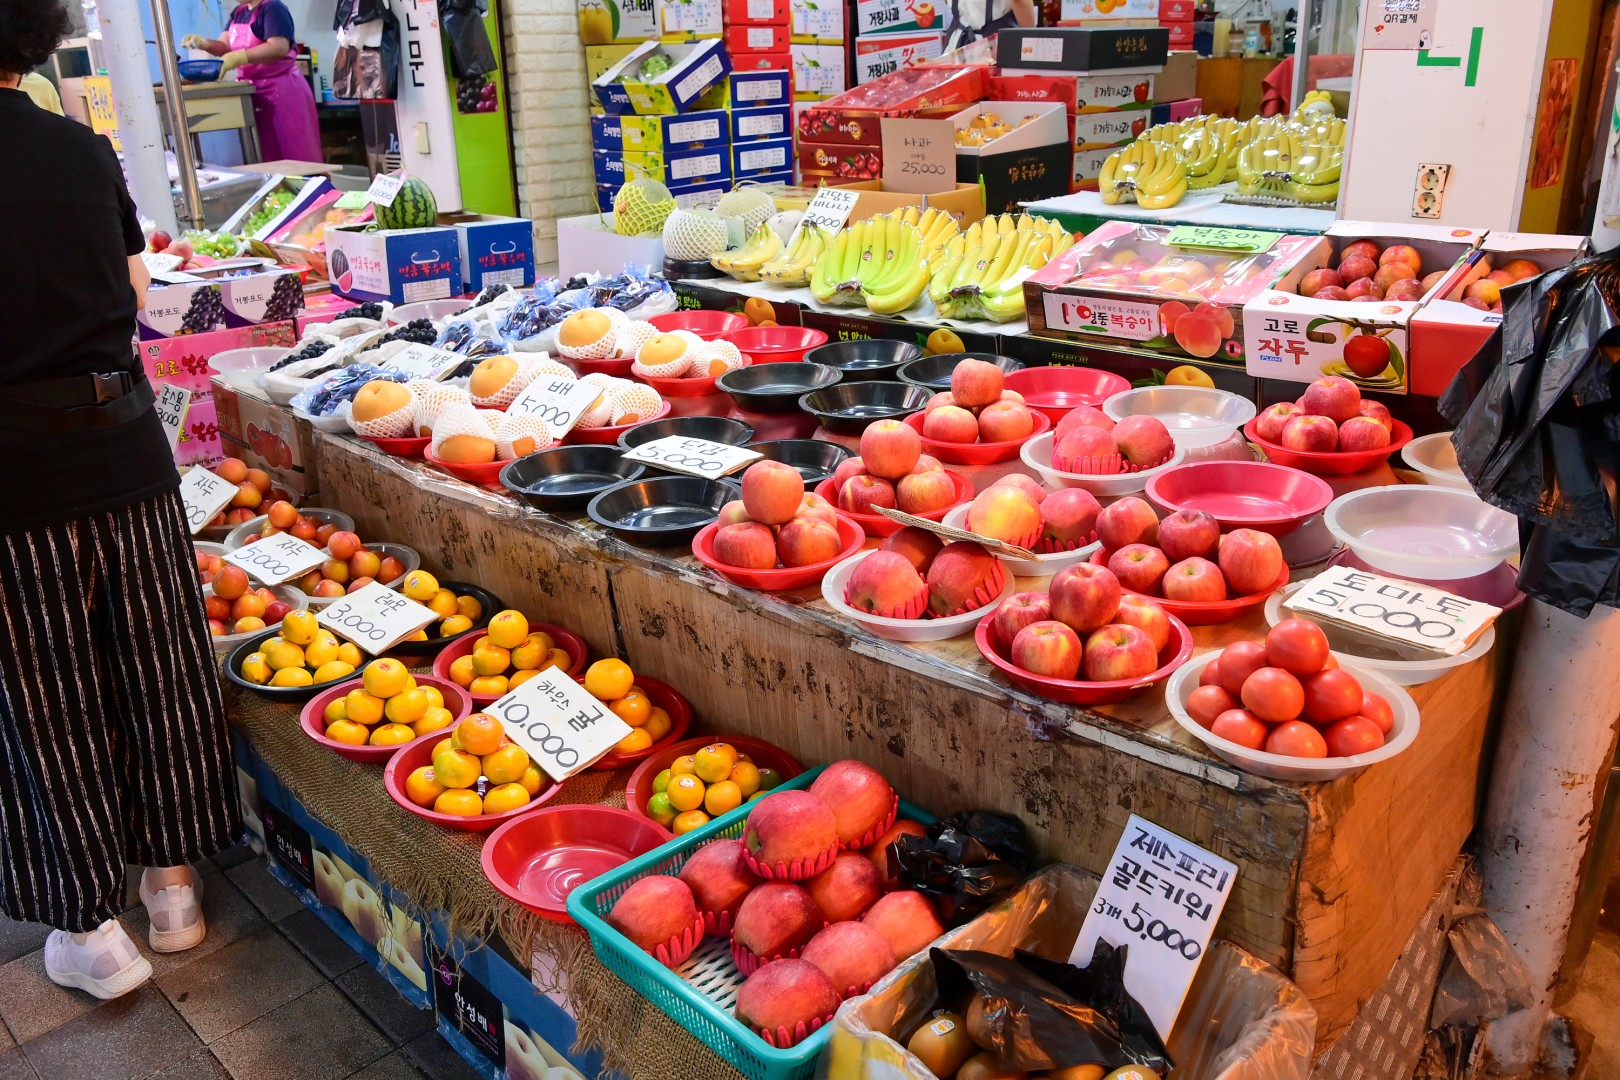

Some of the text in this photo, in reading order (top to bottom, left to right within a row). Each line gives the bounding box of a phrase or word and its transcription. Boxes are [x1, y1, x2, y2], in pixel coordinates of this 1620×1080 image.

[869, 7, 900, 26] 거창사과
[902, 47, 915, 67] 맛
[904, 138, 932, 147] 사과
[813, 200, 850, 212] 바나나
[818, 190, 854, 202] 고당도
[1194, 228, 1261, 240] 복숭아
[235, 294, 265, 305] 거봉포도
[149, 307, 181, 318] 거봉포도
[1076, 305, 1153, 332] 영동 복숭아
[1263, 318, 1301, 335] 고로
[1258, 337, 1310, 365] 자두
[154, 354, 208, 378] 고로 복숭
[548, 380, 574, 396] 배
[192, 421, 218, 442] 복숭
[681, 439, 728, 455] 단감
[193, 475, 219, 497] 자두
[276, 539, 310, 558] 자두
[374, 592, 407, 617] 레몬
[1332, 573, 1472, 619] 토마토
[536, 680, 604, 732] 하우스 귤
[276, 834, 302, 865] 안성배
[1130, 826, 1229, 893] 제스프리
[1112, 854, 1213, 921] 골드키위
[1093, 897, 1123, 920] 3개
[454, 991, 488, 1031] 안성배
